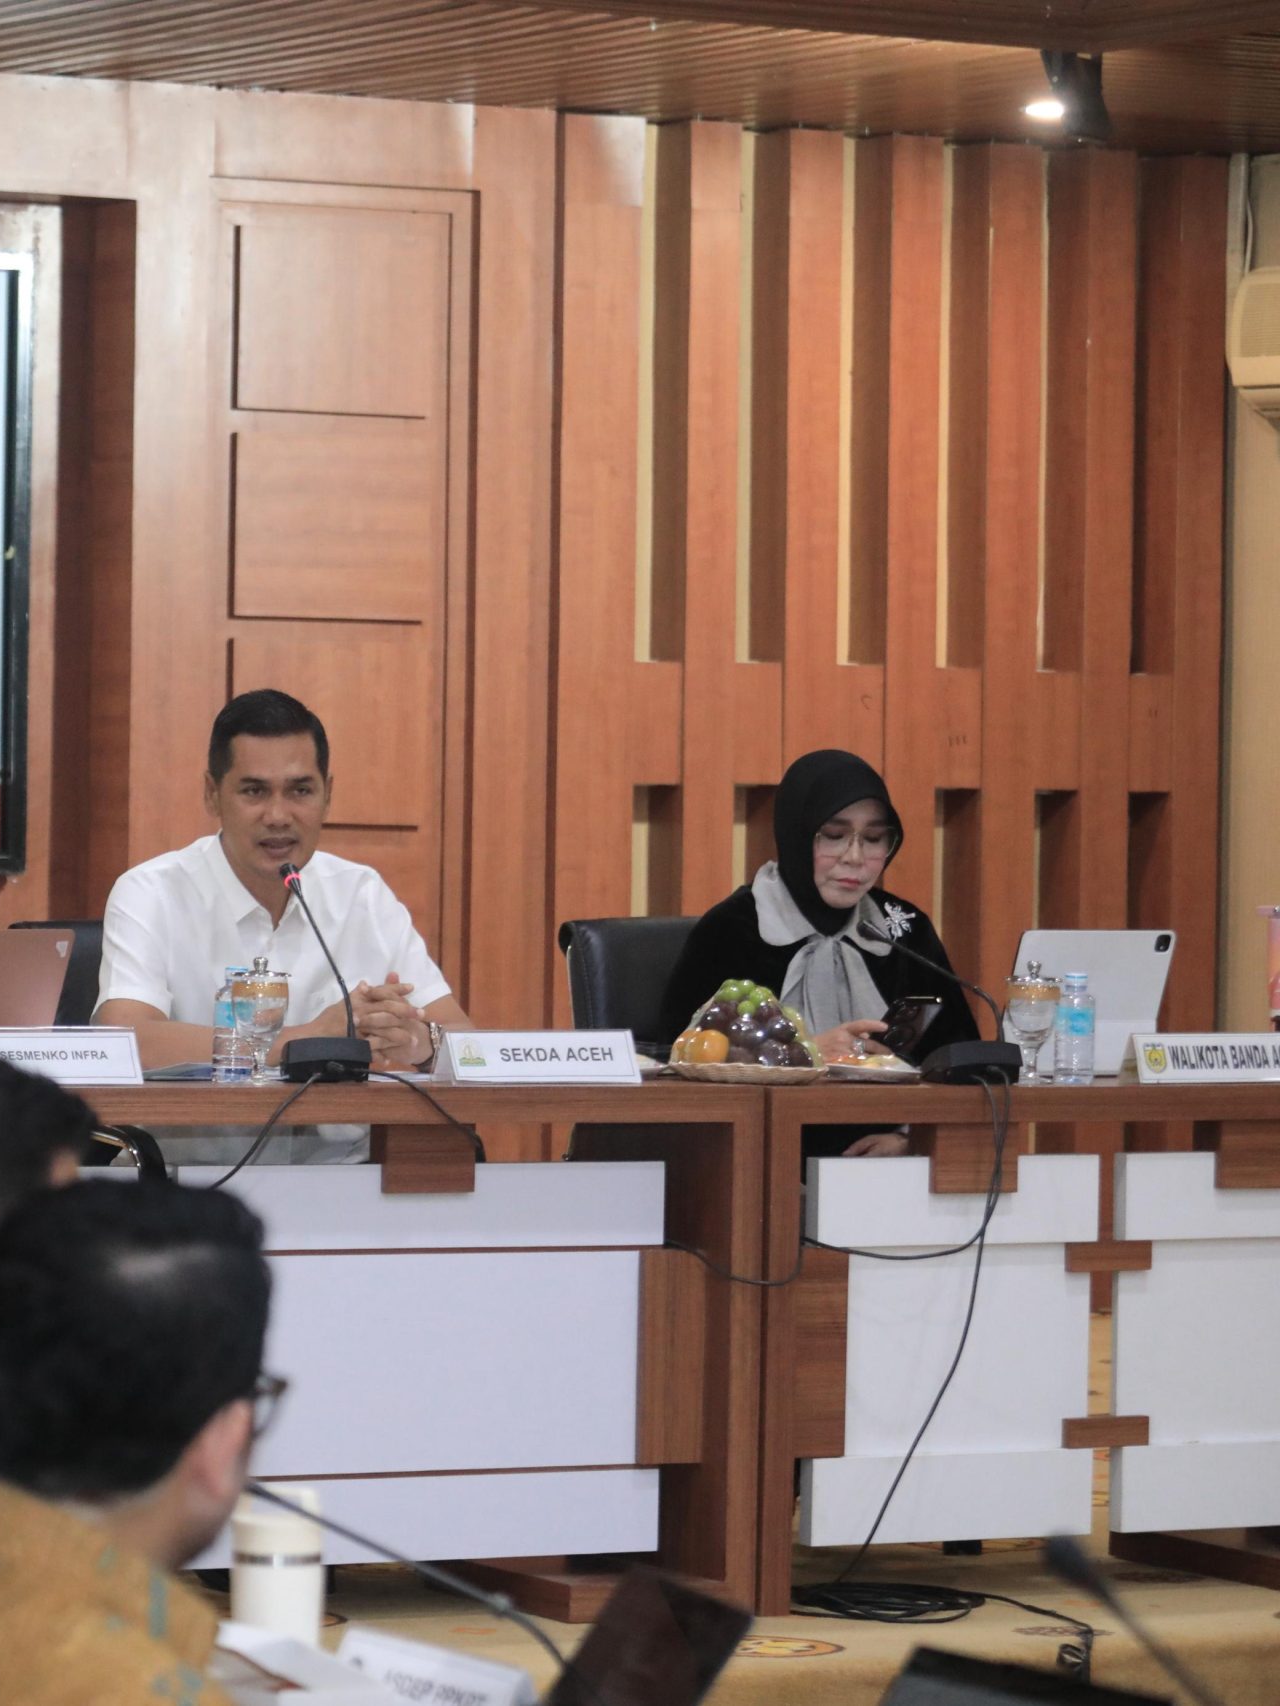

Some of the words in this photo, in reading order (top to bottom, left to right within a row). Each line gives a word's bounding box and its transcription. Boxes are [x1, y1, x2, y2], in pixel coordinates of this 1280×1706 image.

[0, 1050, 68, 1061] SESMENKO
[72, 1050, 108, 1060] INFRA
[499, 1047, 561, 1062] SEKDA
[566, 1047, 613, 1061] ACEH
[1169, 1045, 1229, 1069] WALIKOTA
[1230, 1045, 1270, 1069] BANDA
